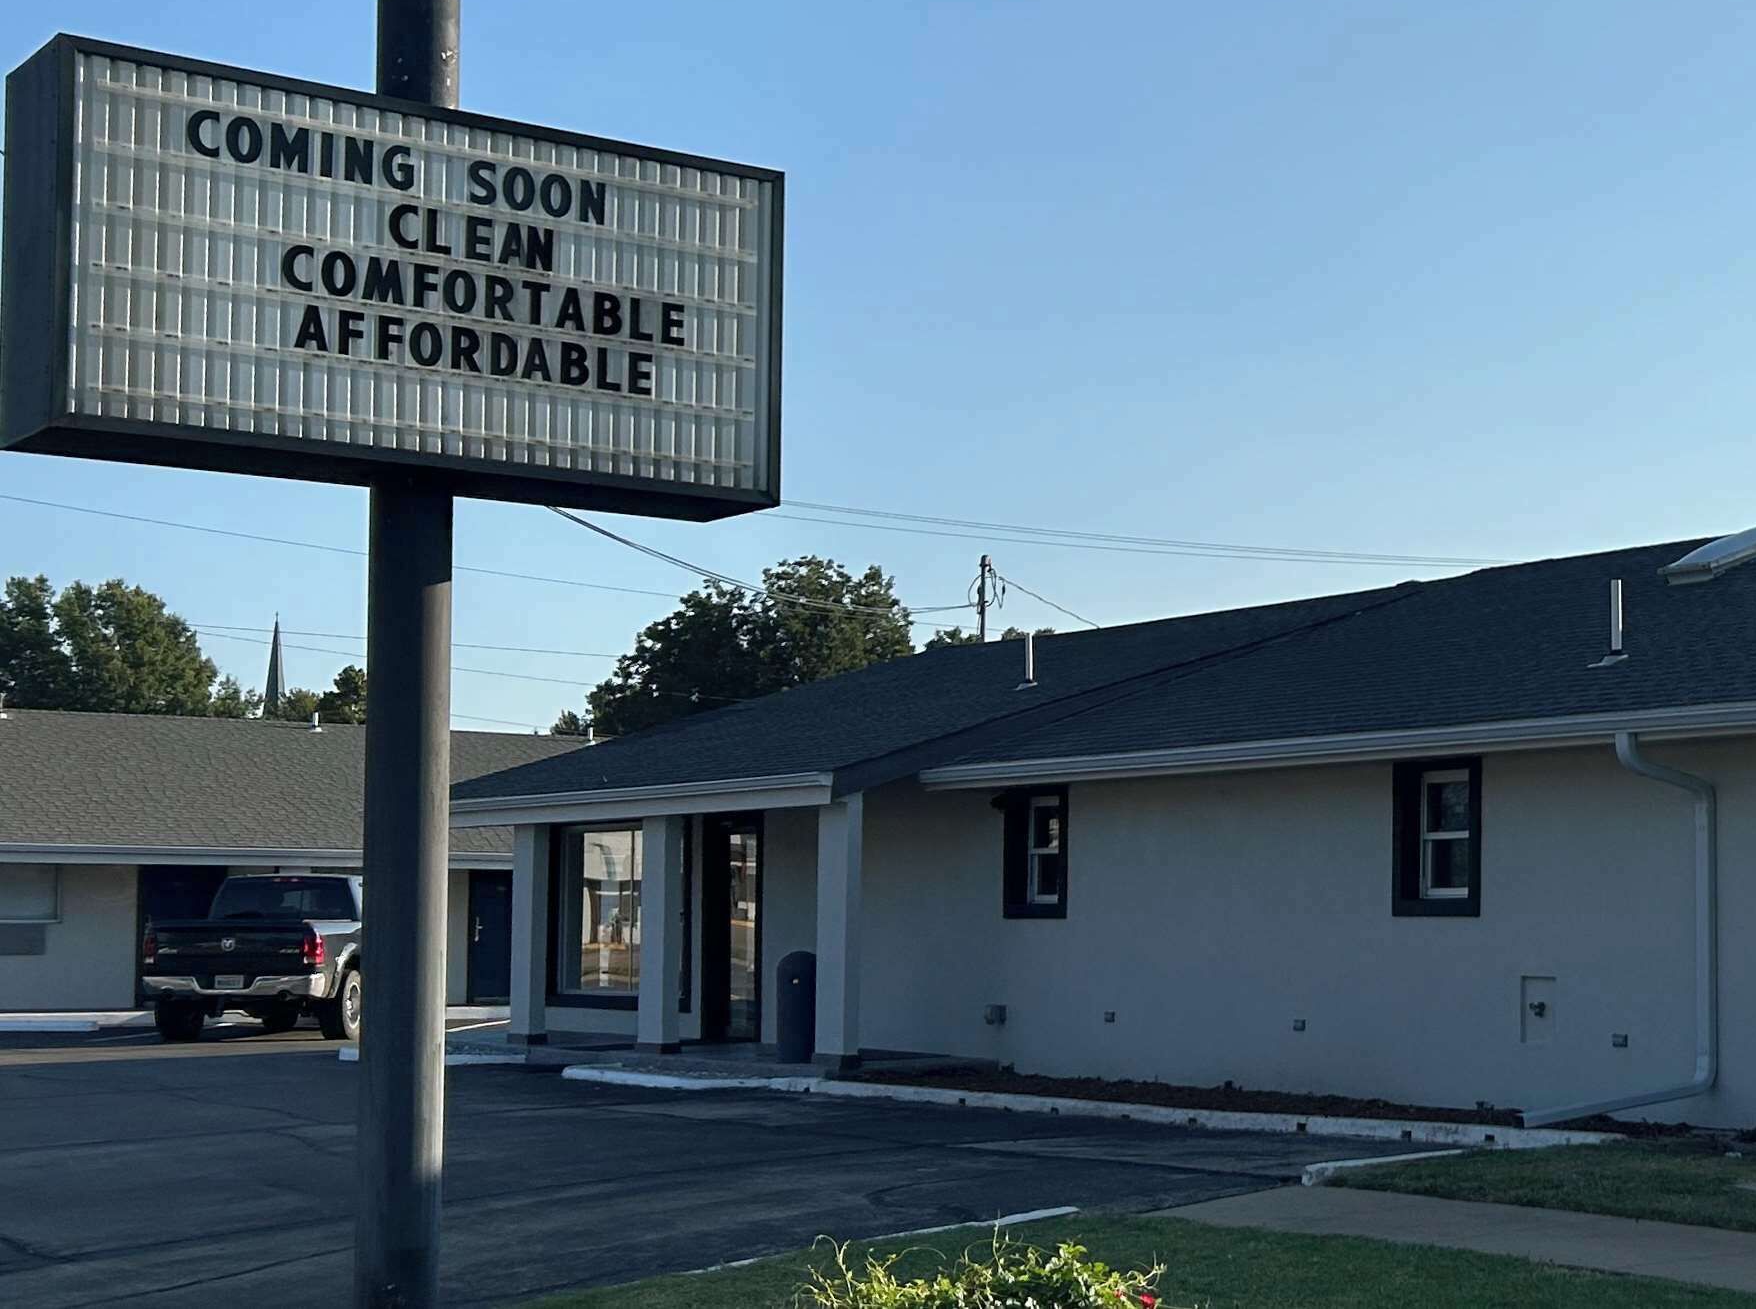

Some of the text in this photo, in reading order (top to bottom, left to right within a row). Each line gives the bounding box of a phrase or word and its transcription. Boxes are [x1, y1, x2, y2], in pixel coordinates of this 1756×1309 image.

[187, 110, 606, 225] COMING SOON
[389, 204, 554, 272] CLEAN
[282, 245, 685, 346] COMFORTABLE
[296, 305, 653, 396] AFFORDABLE
